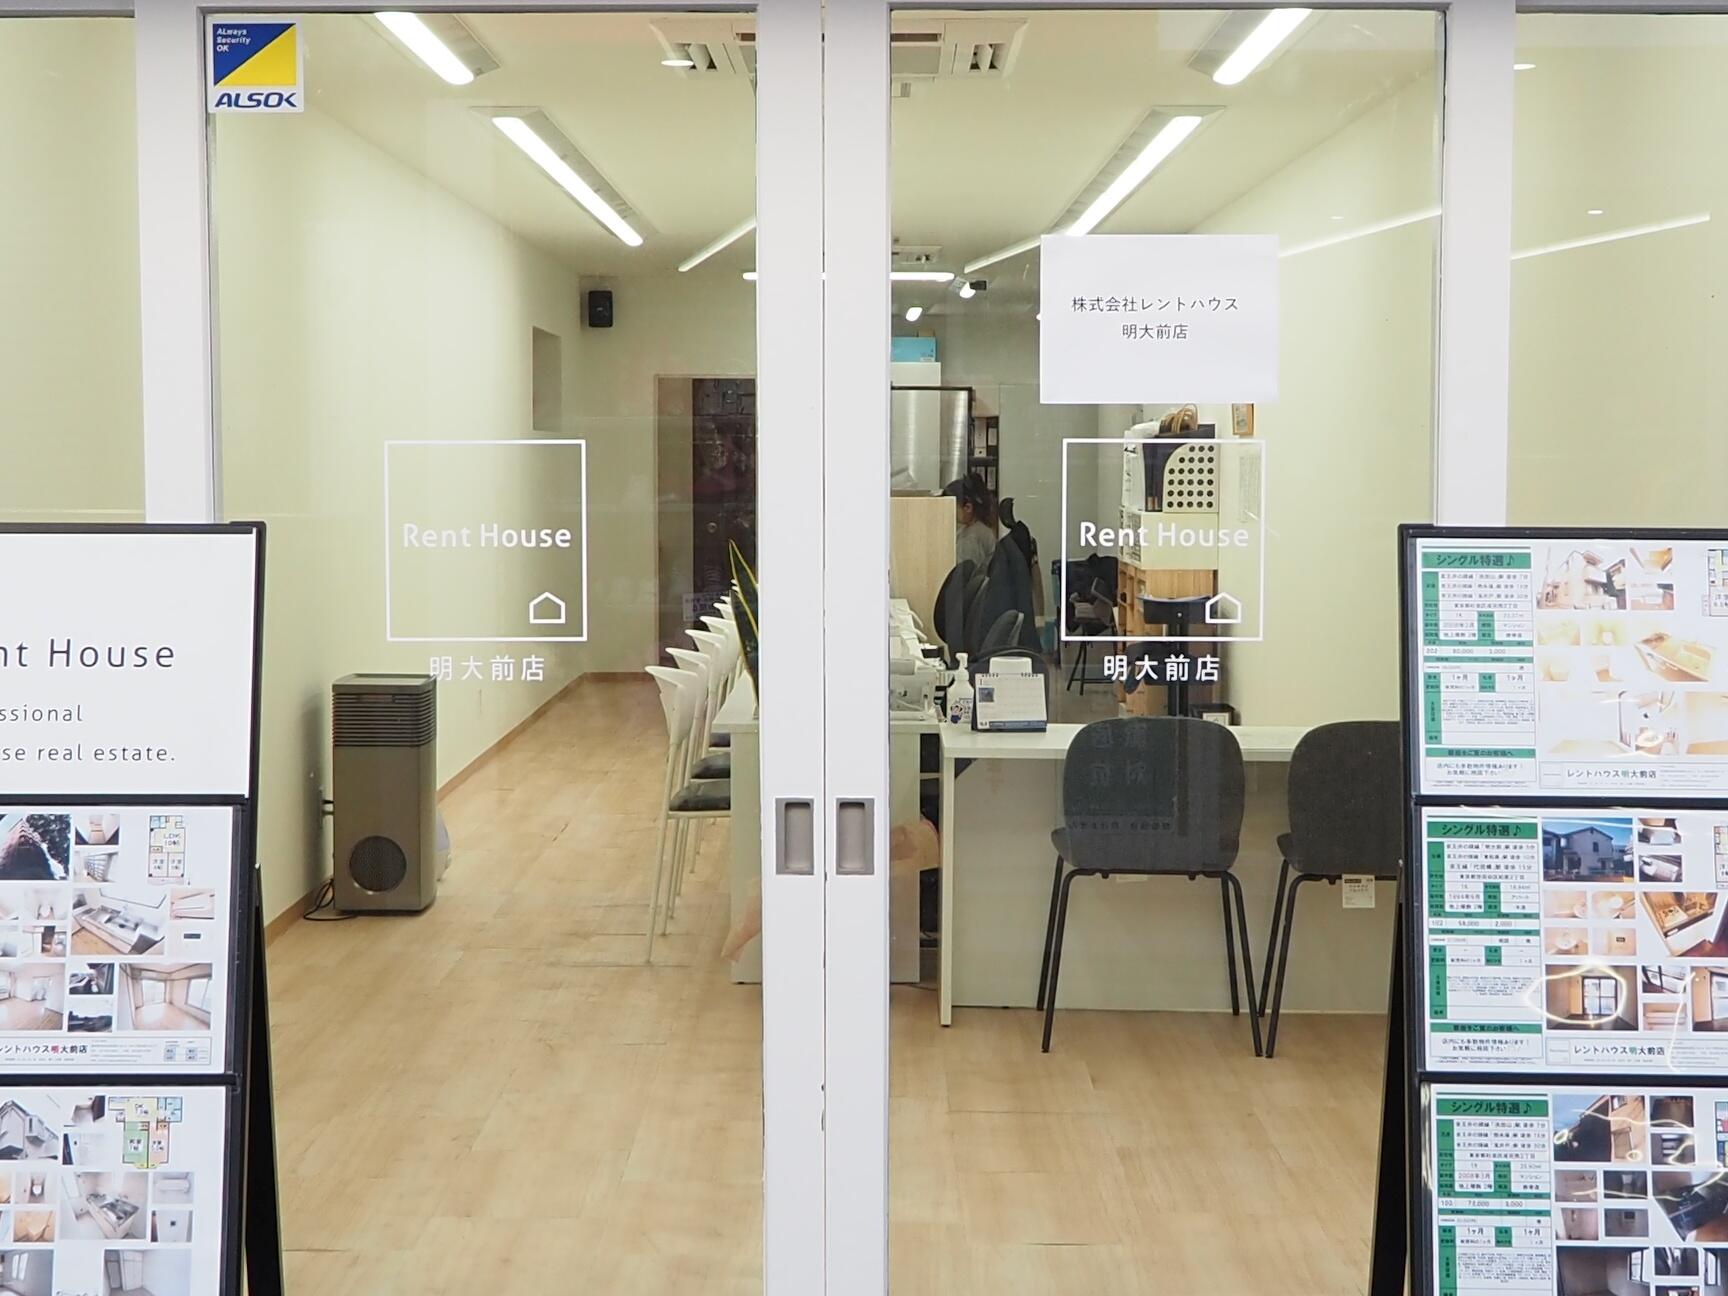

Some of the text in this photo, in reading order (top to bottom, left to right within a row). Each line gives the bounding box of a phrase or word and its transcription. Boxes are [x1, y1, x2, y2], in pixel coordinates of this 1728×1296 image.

[216, 36, 251, 45] Security
[214, 92, 297, 109] ALSOK
[1071, 295, 1239, 313] 株式会社レントハウス
[1121, 323, 1189, 340] 明大前店
[402, 523, 572, 548] Rent House
[1079, 521, 1250, 548] Rent House
[49, 638, 174, 668] House
[429, 655, 545, 682] 明大前店
[1103, 653, 1220, 682] 明大前店
[37, 743, 82, 761] real
[93, 747, 175, 762] estate.
